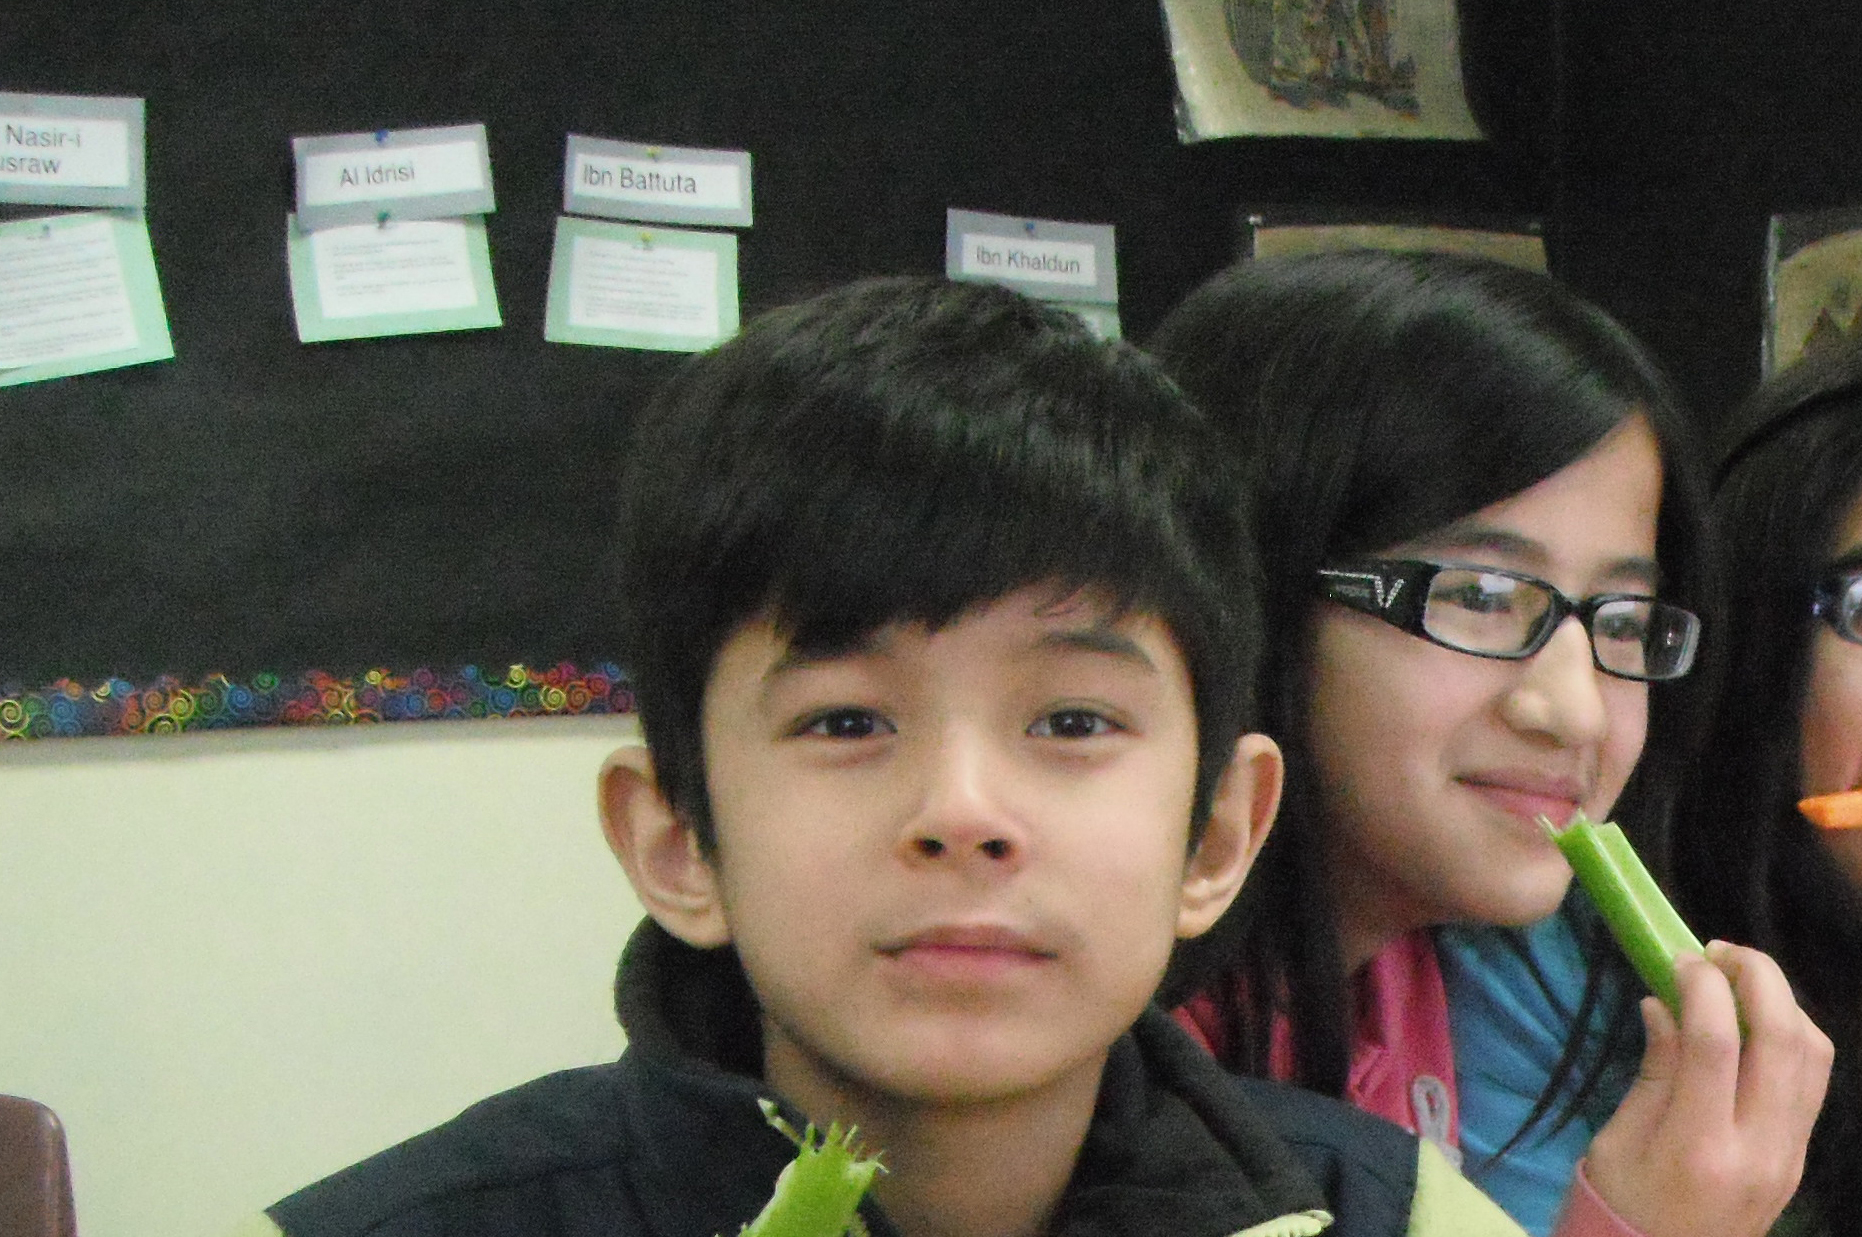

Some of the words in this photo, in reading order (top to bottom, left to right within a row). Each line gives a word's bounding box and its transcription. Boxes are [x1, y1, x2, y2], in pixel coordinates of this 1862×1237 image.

[6, 124, 81, 148] Nasir-i
[341, 167, 360, 187] Al
[366, 161, 415, 184] Idrisi
[583, 164, 613, 187] Ibn
[620, 167, 698, 194] Battuta
[976, 245, 1001, 266] Ibn
[1007, 249, 1081, 274] Khaldun
